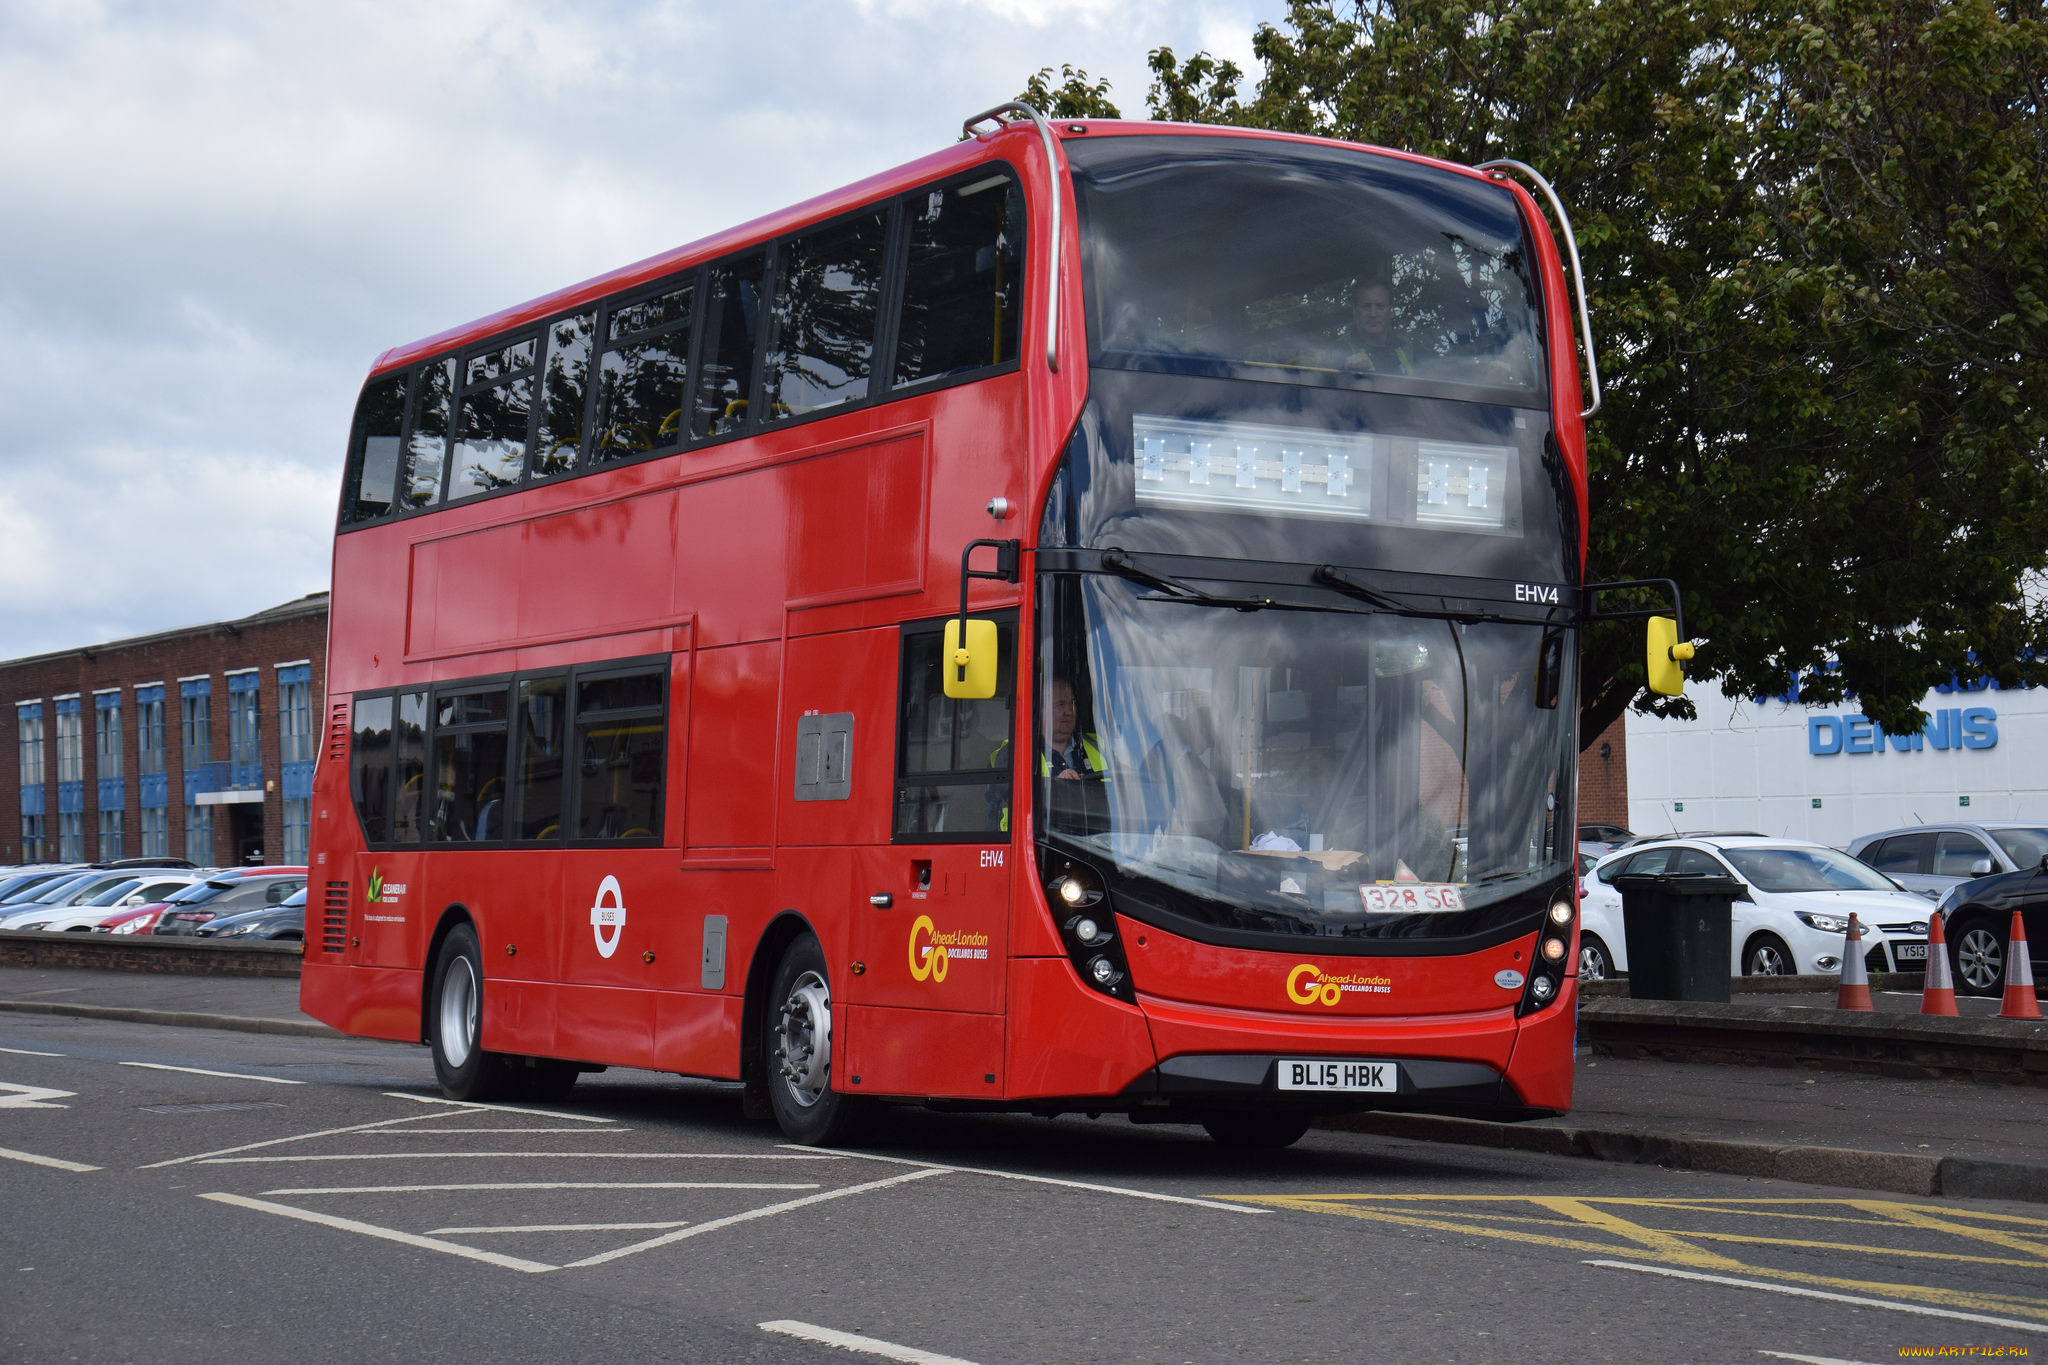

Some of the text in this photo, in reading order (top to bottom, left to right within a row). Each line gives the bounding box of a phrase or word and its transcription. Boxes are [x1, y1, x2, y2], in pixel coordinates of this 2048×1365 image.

[1515, 583, 1559, 604] EHV4
[980, 850, 1004, 868] EHV4
[1369, 888, 1458, 910] 328 SG
[601, 911, 615, 922] BUSES
[908, 915, 988, 983] Go Ahead-London
[947, 948, 988, 960] DOCKLANDS BUSES
[1903, 945, 1926, 957] YS13
[1286, 963, 1391, 1007] Go Ahead-London
[1340, 984, 1391, 993] DOCKLANDS BUSES
[1292, 1063, 1383, 1087] BL15 HBK
